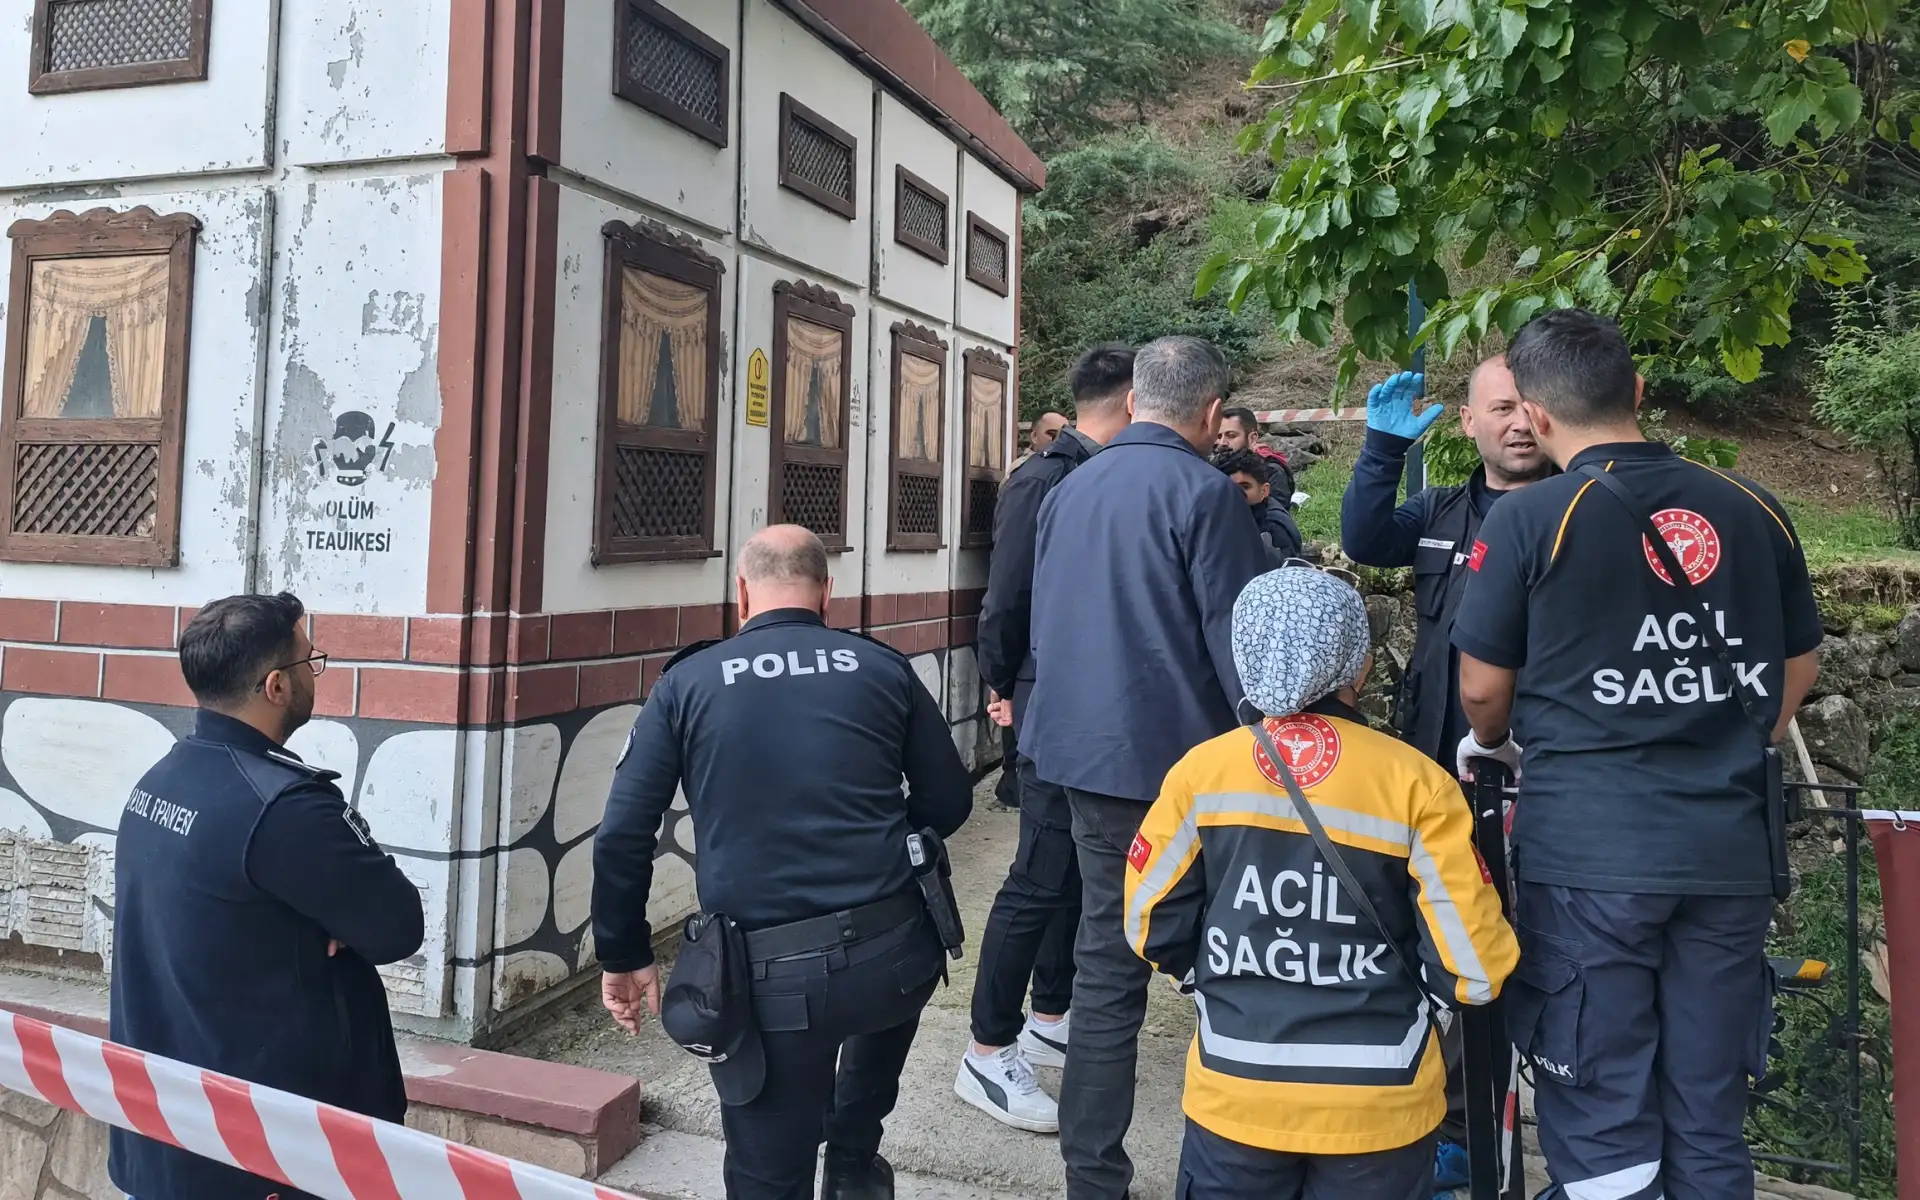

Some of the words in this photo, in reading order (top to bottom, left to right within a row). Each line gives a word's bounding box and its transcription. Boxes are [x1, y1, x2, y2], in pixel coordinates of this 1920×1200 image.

[721, 649, 859, 685] POLİS
[1592, 657, 1769, 705] SAĞLK
[1232, 861, 1357, 924] ACİL
[1207, 926, 1388, 986] SAĞLIK
